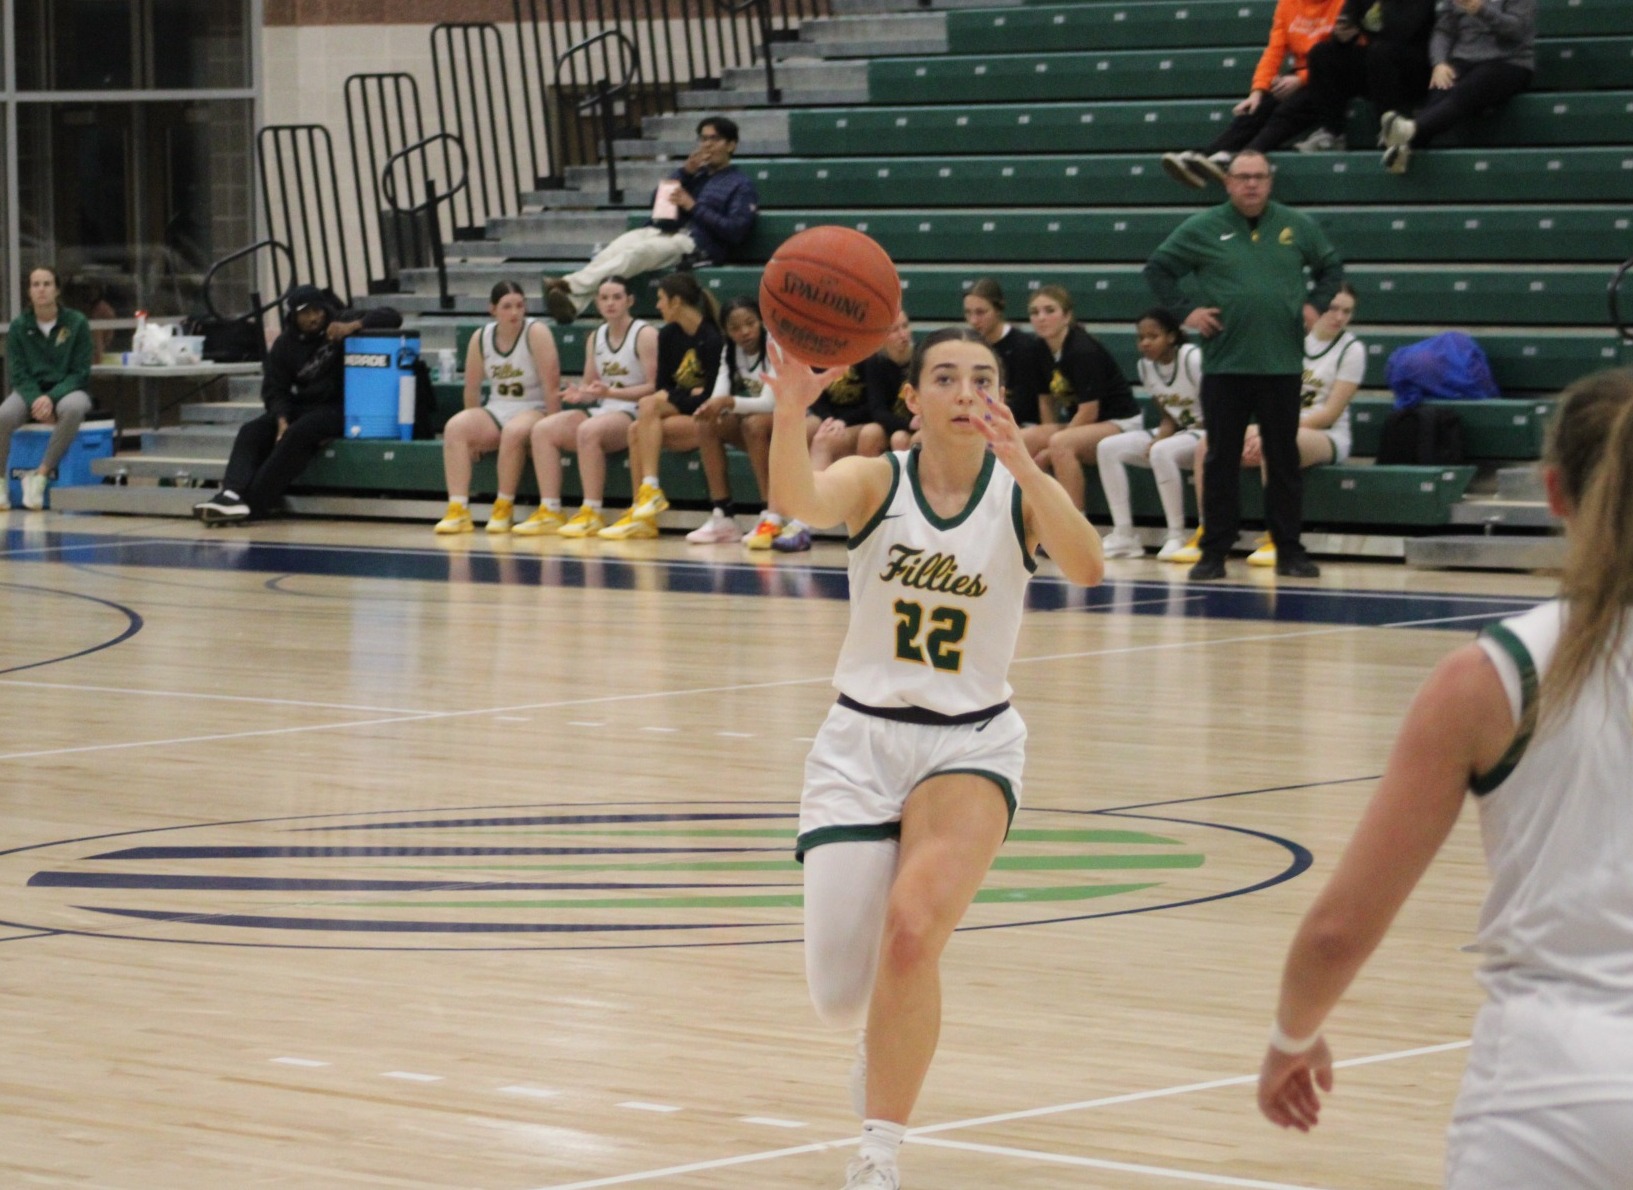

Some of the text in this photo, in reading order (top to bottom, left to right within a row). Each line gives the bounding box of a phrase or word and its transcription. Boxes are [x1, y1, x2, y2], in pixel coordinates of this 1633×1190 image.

[781, 271, 869, 323] SPALDING
[880, 544, 987, 597] Fillies
[893, 598, 971, 674] 22
